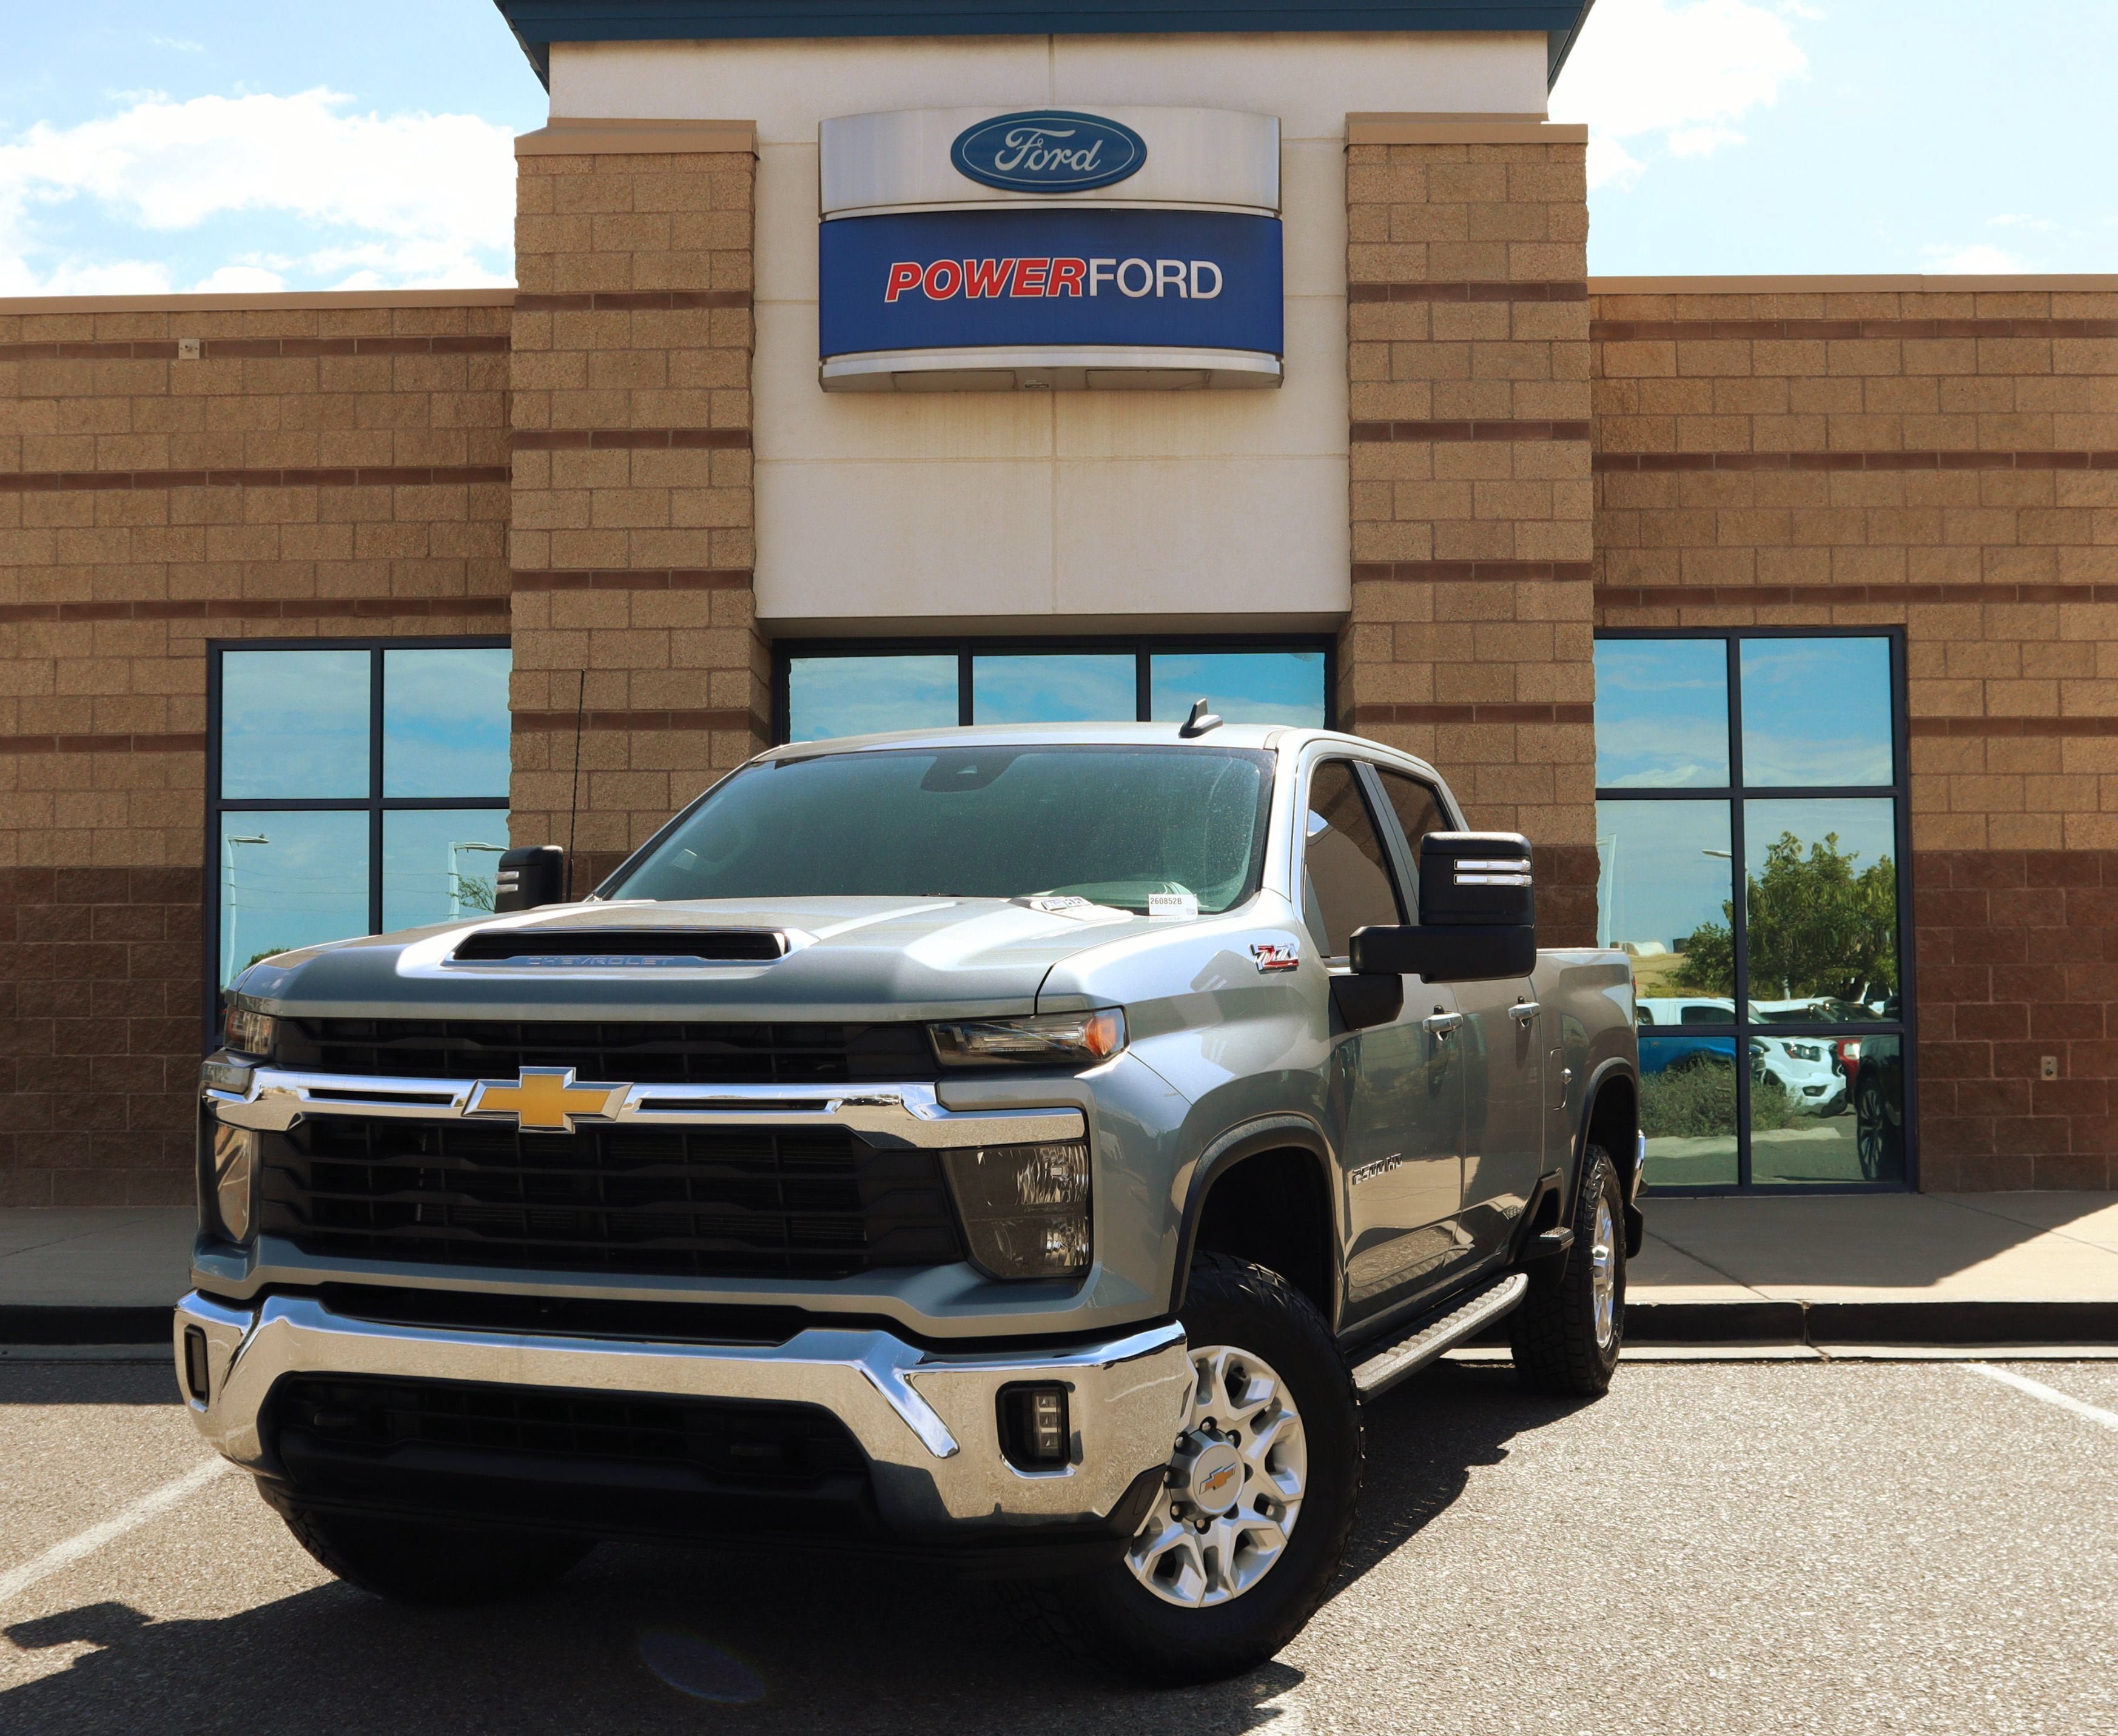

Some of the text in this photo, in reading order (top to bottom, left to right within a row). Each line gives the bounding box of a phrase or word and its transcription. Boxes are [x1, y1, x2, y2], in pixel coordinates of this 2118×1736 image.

[994, 127, 1103, 172] Ford
[528, 957, 675, 965] CHEVROLET
[1247, 942, 1299, 975] Z71
